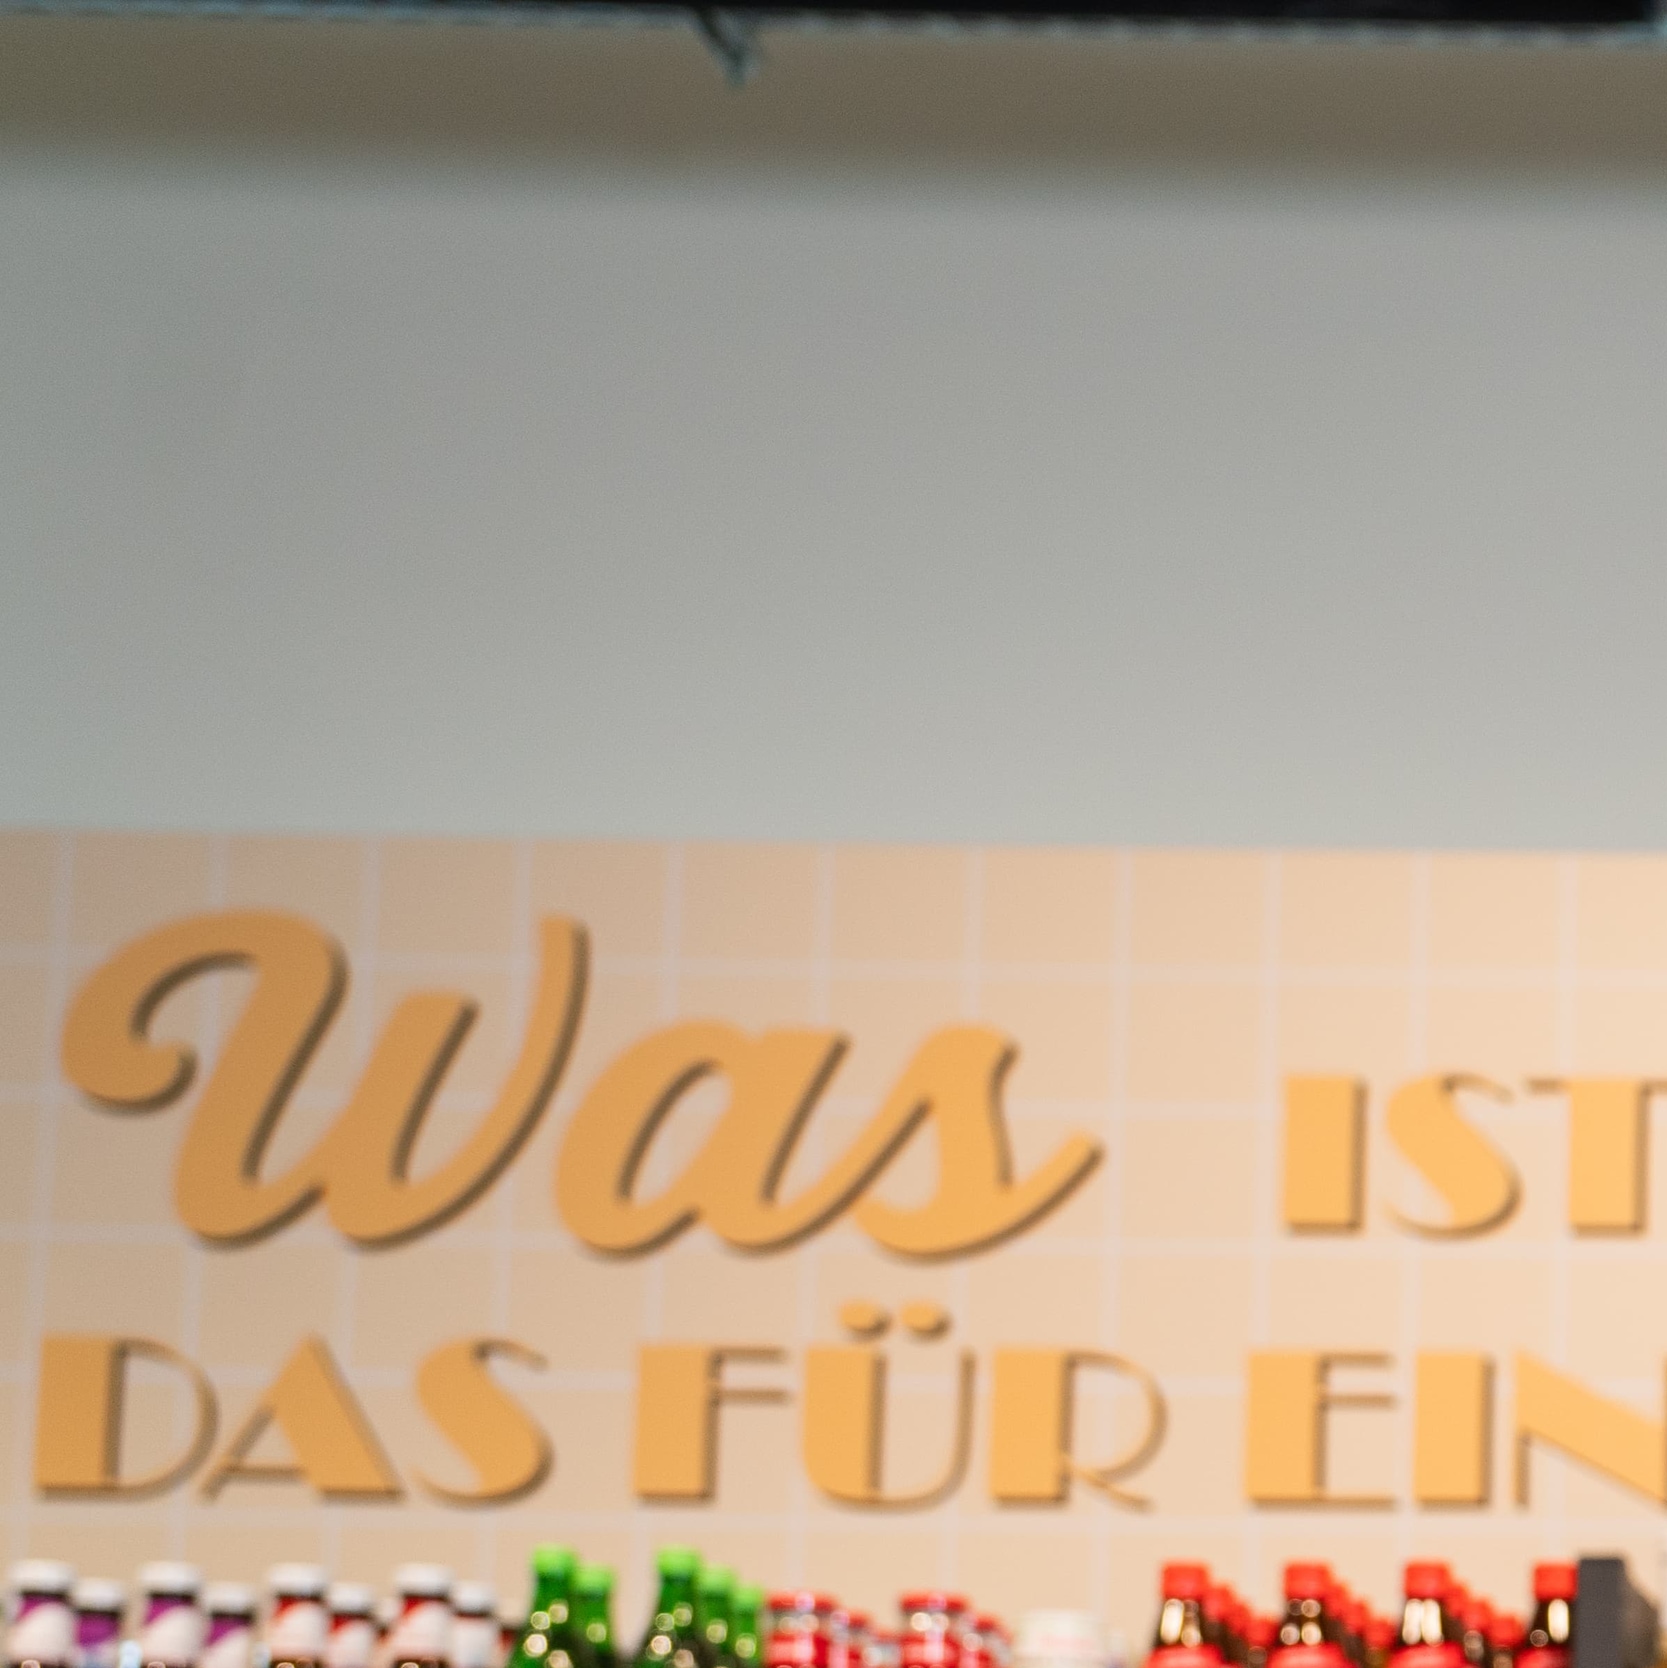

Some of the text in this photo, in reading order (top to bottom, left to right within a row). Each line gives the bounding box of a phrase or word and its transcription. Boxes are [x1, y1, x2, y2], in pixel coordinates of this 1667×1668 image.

[60, 909, 1103, 1262] Was
[33, 1333, 552, 1500] DAS
[631, 1302, 1170, 1508] FÜR
